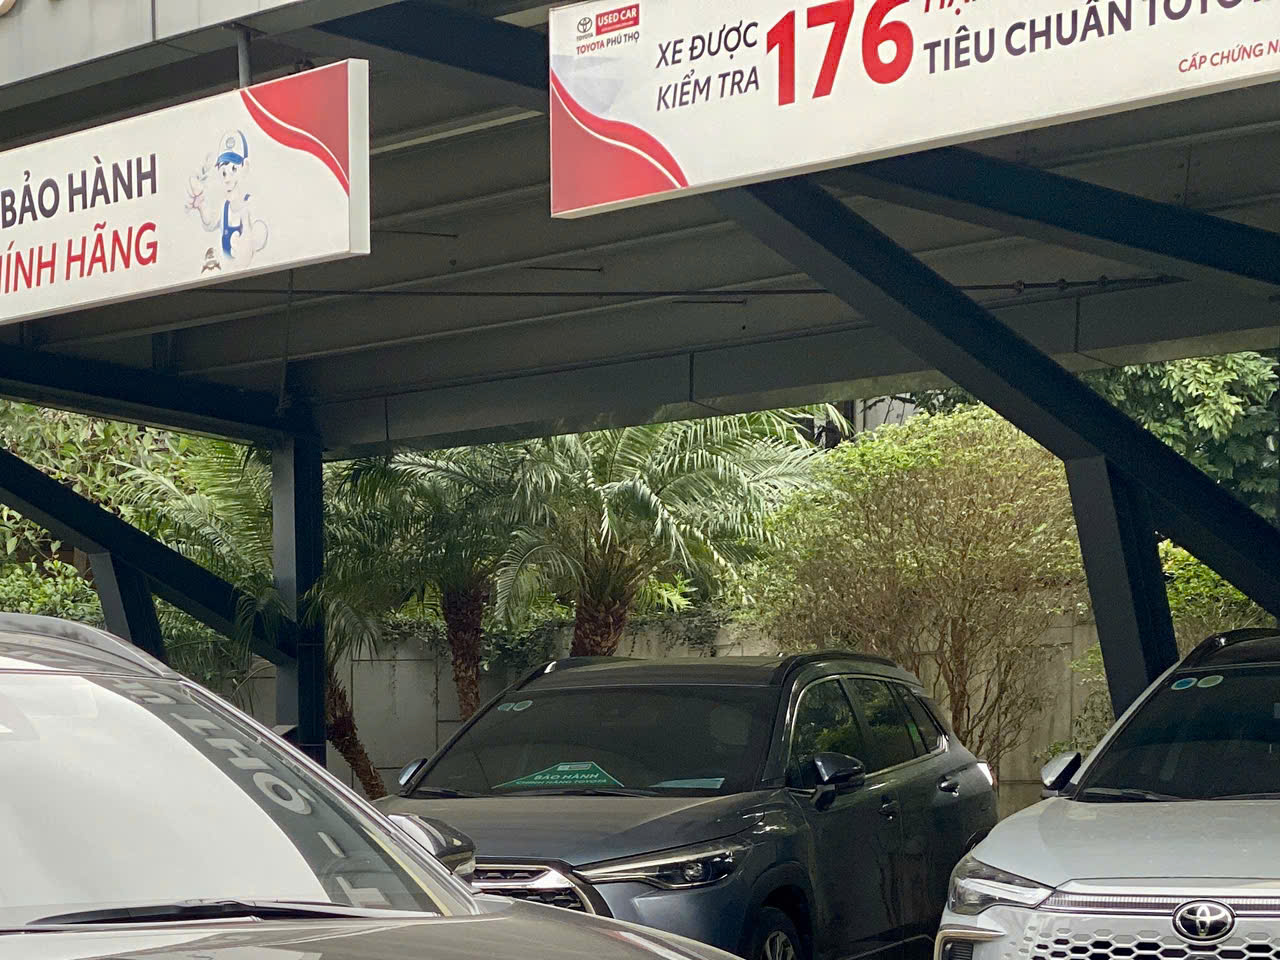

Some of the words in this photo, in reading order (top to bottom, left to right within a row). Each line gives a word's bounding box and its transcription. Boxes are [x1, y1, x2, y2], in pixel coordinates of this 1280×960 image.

[597, 13, 620, 27] USED
[620, 7, 637, 21] CAR
[576, 40, 605, 55] TOYOTA
[655, 38, 684, 69] XE
[688, 20, 759, 61] ĐƯỢC
[766, 0, 914, 107] 176
[923, 25, 996, 75] TIÊU
[1178, 51, 1207, 73] CẤP
[1210, 43, 1264, 67] CHỨNG
[656, 69, 711, 111] KIỂM
[718, 66, 760, 99] TRA
[0, 169, 60, 229] BẢO
[67, 153, 157, 213] HÀNH
[65, 221, 158, 281] HÃNG
